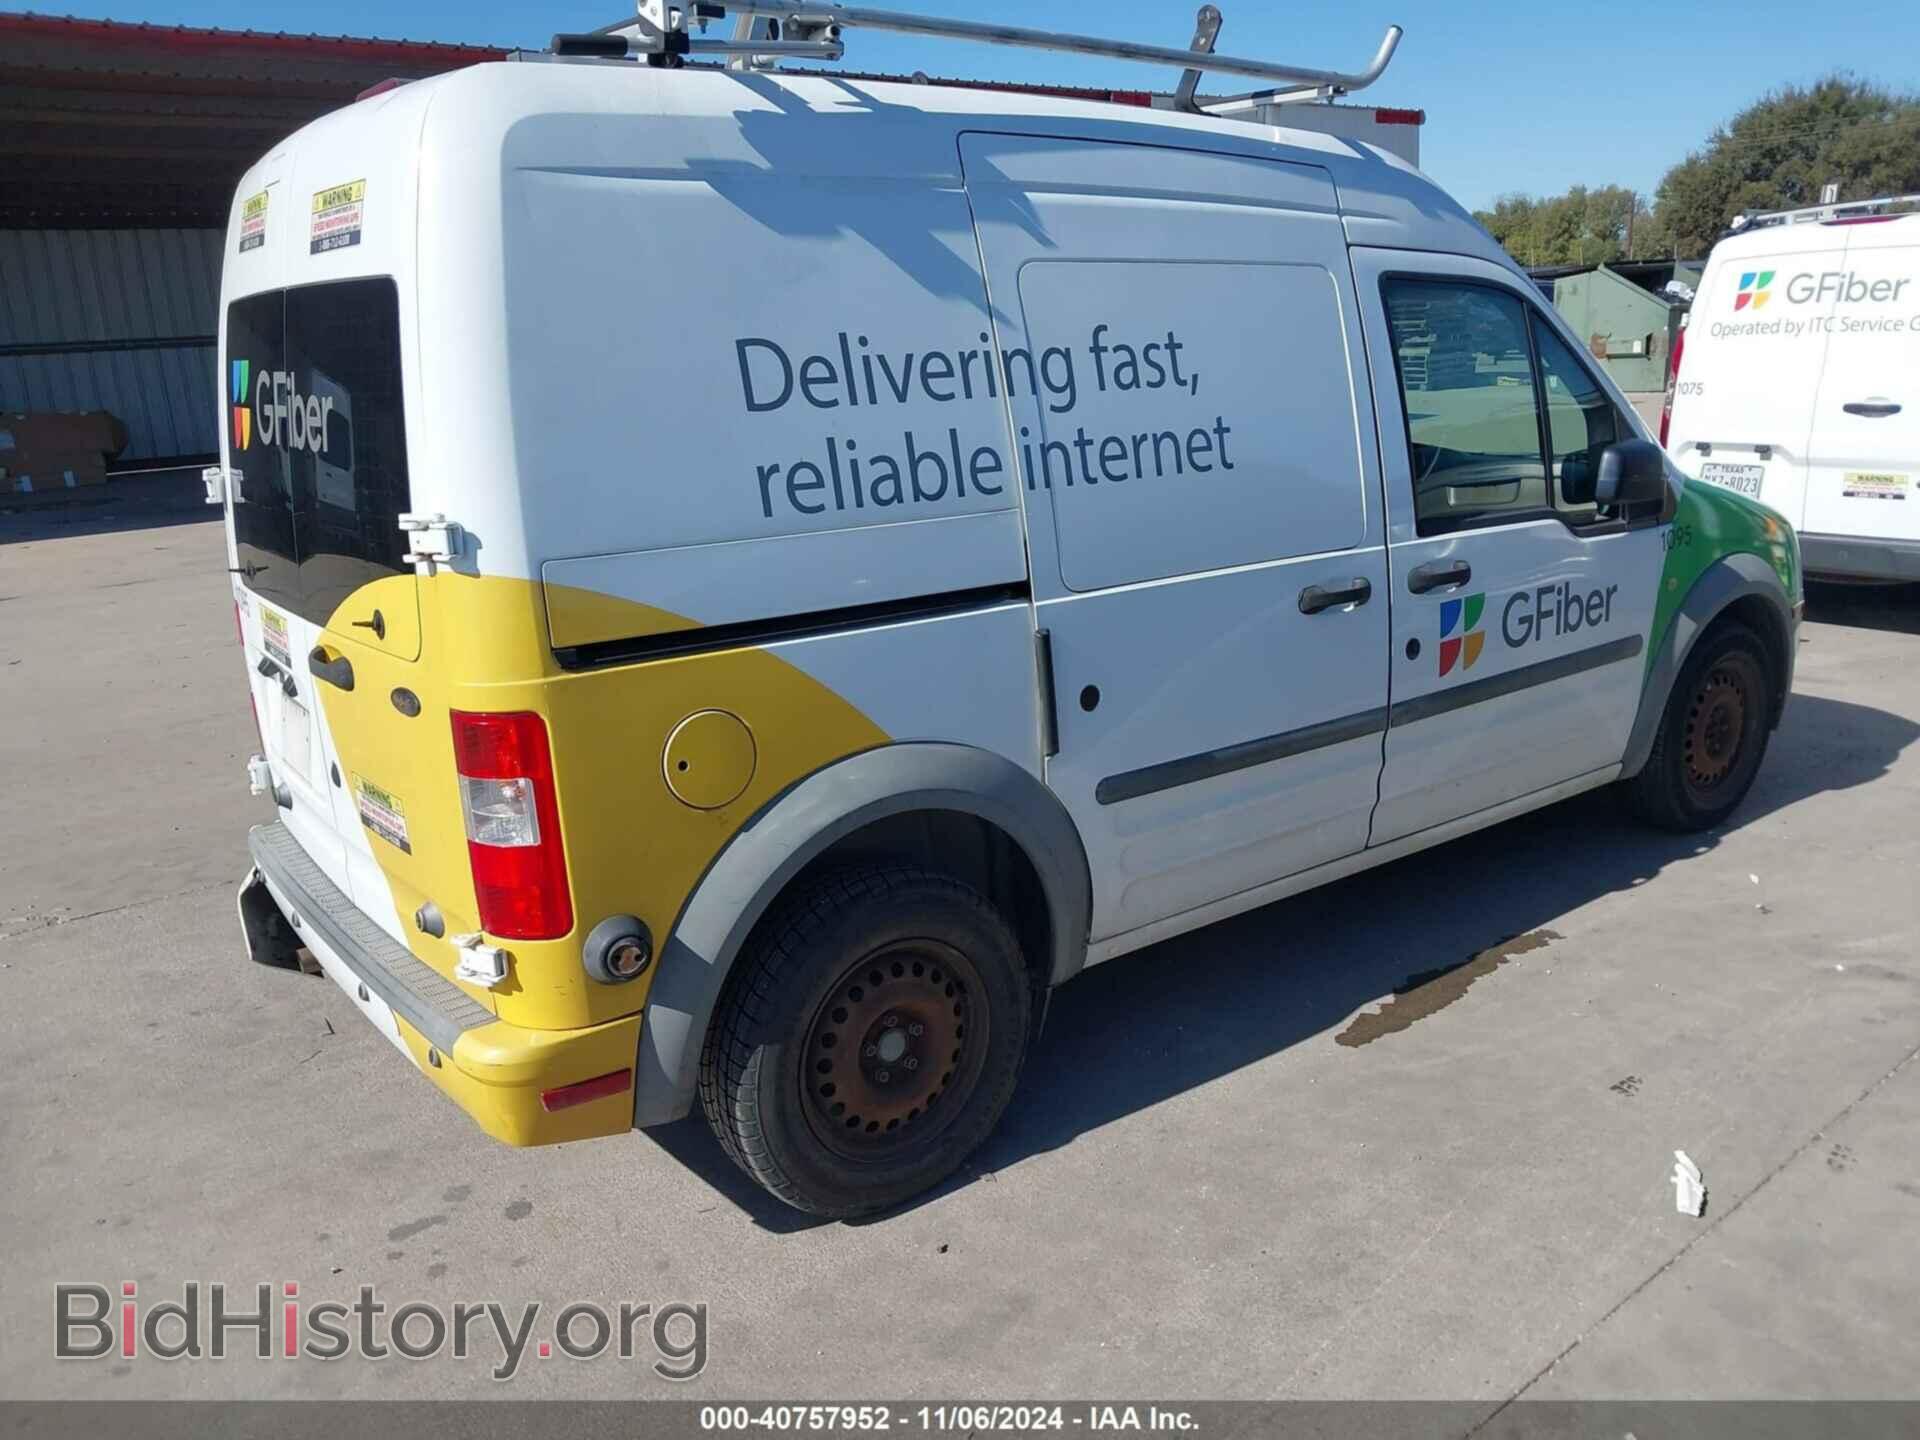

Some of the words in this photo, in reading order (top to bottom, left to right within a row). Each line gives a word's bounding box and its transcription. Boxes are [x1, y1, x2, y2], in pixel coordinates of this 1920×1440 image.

[1786, 271, 1911, 304] GFiber
[1711, 318, 1781, 340] Operated
[1785, 317, 1806, 337] by
[1808, 315, 1837, 333] ITC
[1840, 315, 1905, 333] Service
[735, 332, 1077, 413] Delivering
[1089, 324, 1199, 396] fast,
[1678, 382, 1705, 396] 1075
[256, 370, 333, 452] GFiber
[756, 427, 1003, 518] reliable
[1020, 416, 1235, 491] internet
[1502, 581, 1618, 648] GFiber
